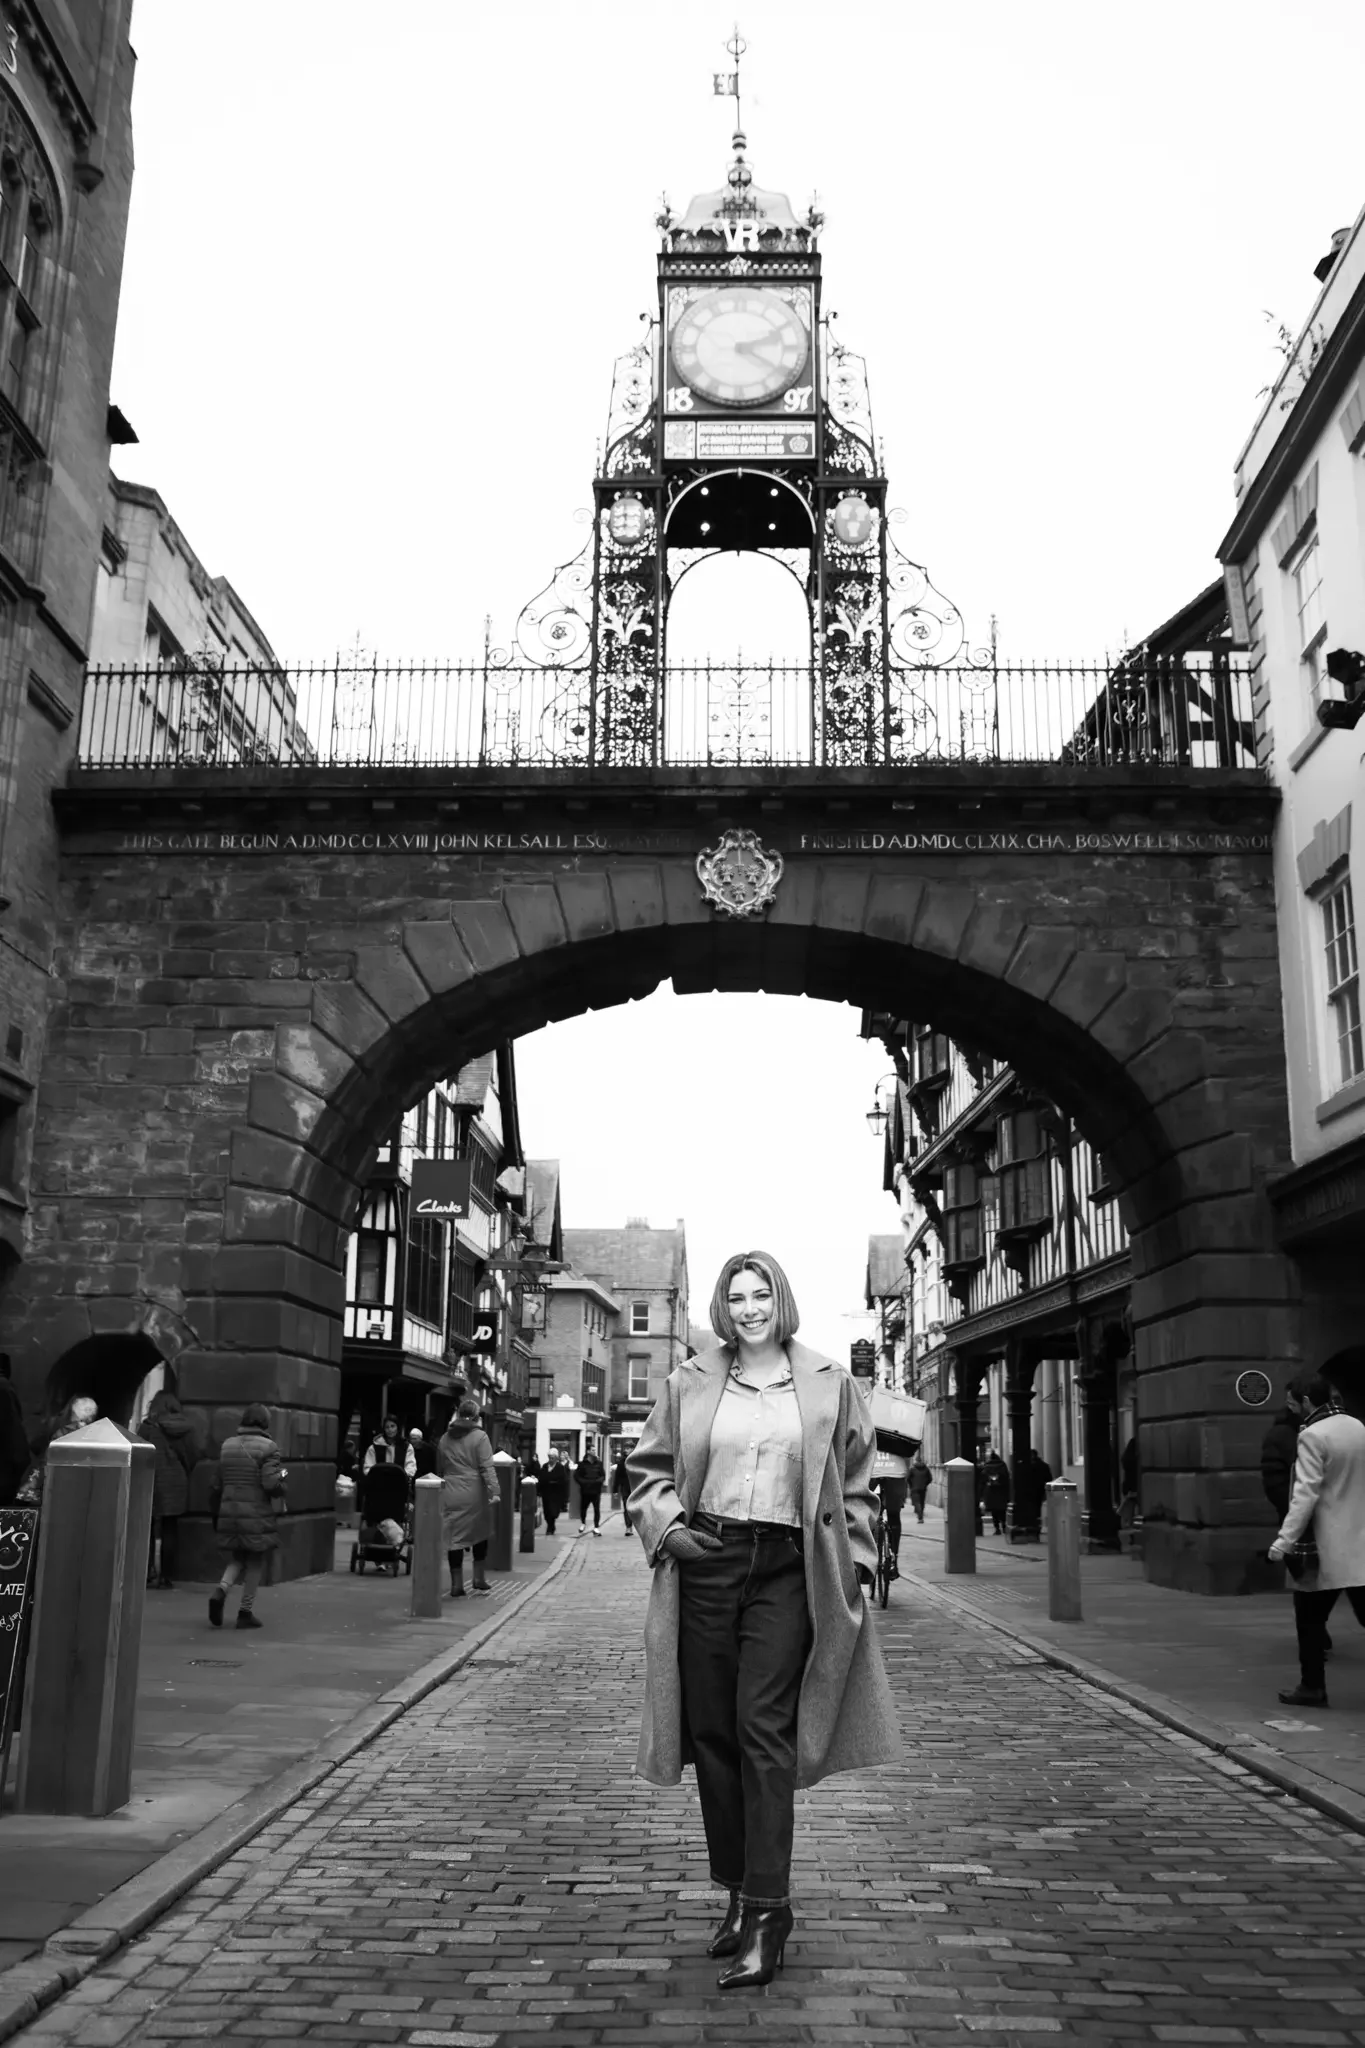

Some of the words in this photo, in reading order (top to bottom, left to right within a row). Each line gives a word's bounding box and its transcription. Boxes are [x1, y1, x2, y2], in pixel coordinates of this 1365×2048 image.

[721, 219, 760, 252] VR
[668, 387, 694, 412] 18
[784, 385, 813, 412] 97
[220, 834, 278, 849] BEGUN
[433, 834, 479, 853] JOHN
[483, 834, 568, 849] KELSALL
[800, 834, 885, 849] FINISHED
[1074, 834, 1169, 849] BOSWELL
[416, 1199, 462, 1213] Clarks
[522, 1283, 546, 1293] WHS
[471, 1325, 493, 1340] JD
